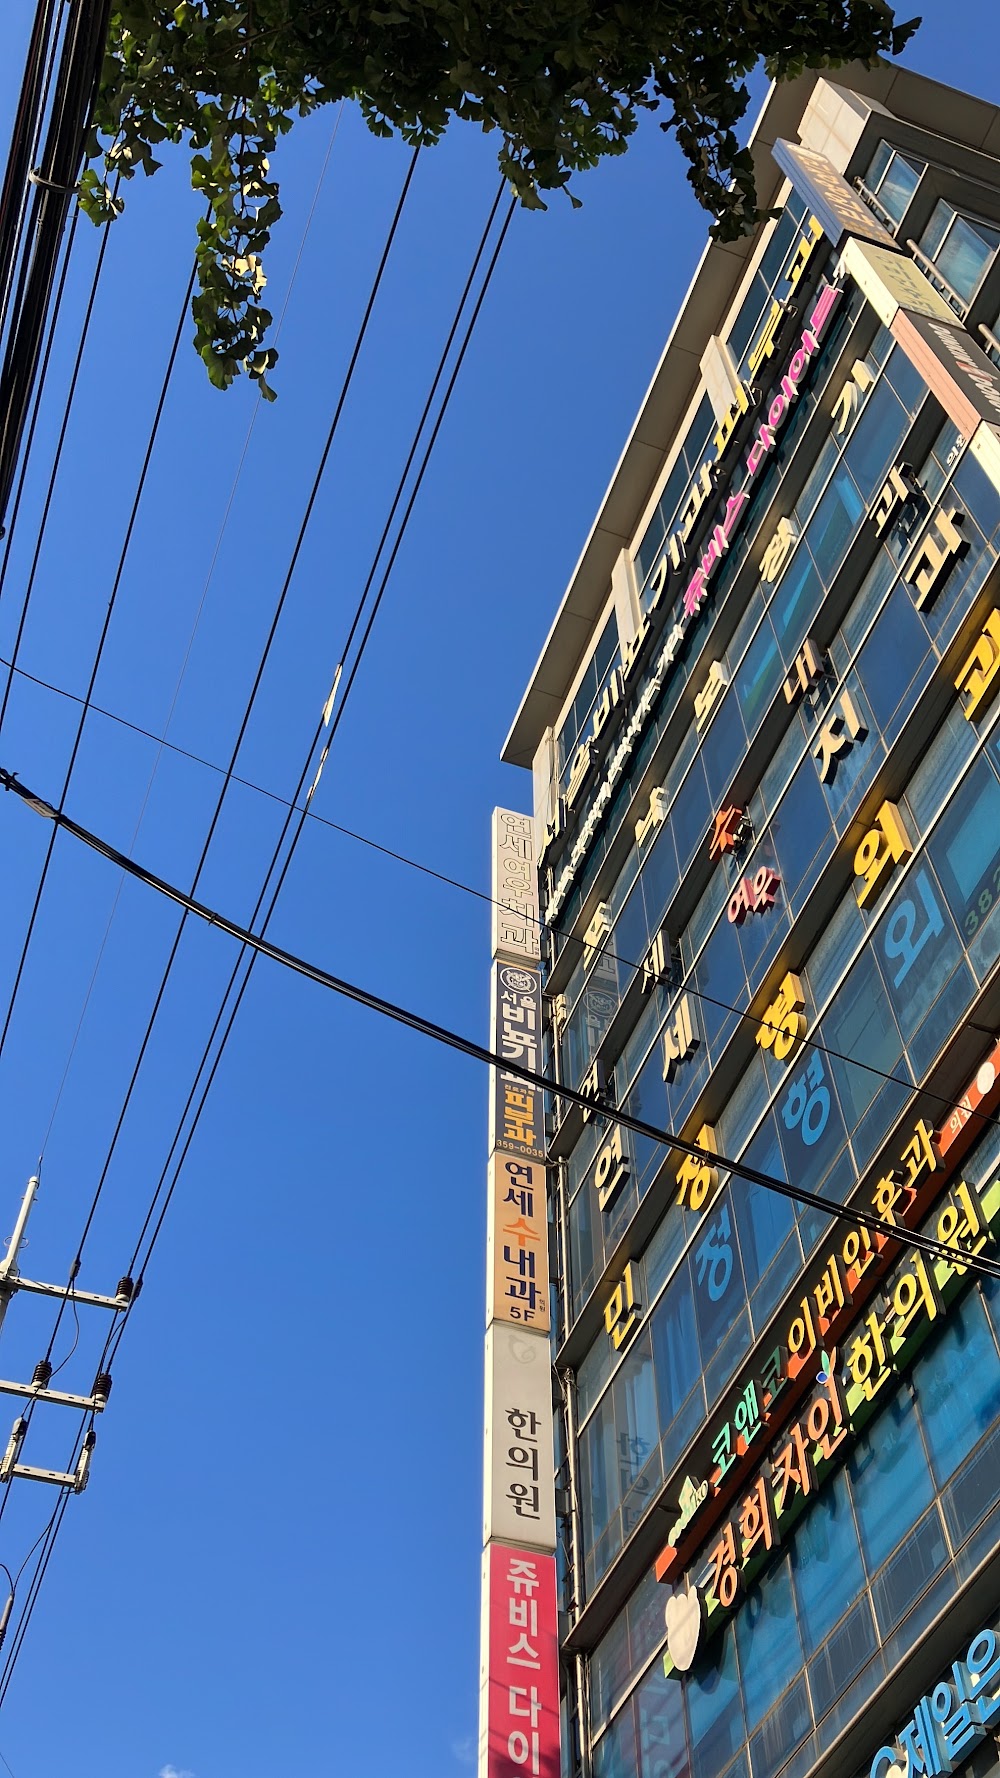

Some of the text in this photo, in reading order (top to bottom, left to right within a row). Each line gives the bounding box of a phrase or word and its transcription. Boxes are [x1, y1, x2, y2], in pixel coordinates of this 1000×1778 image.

[712, 215, 824, 462] 피부과
[683, 492, 748, 618] 쥬비스
[747, 284, 840, 476] 다이어트
[499, 813, 539, 954] 연세여우치과
[501, 990, 537, 1011] 서울
[496, 1139, 544, 1158] 359-0035
[503, 1090, 537, 1147] 피부과
[949, 1094, 973, 1135] 의원
[503, 1161, 542, 1310] 연세수내과
[509, 1306, 536, 1322] 5F
[505, 1407, 542, 1520] 한의원
[506, 1558, 542, 1778] 쥬비스 다이
